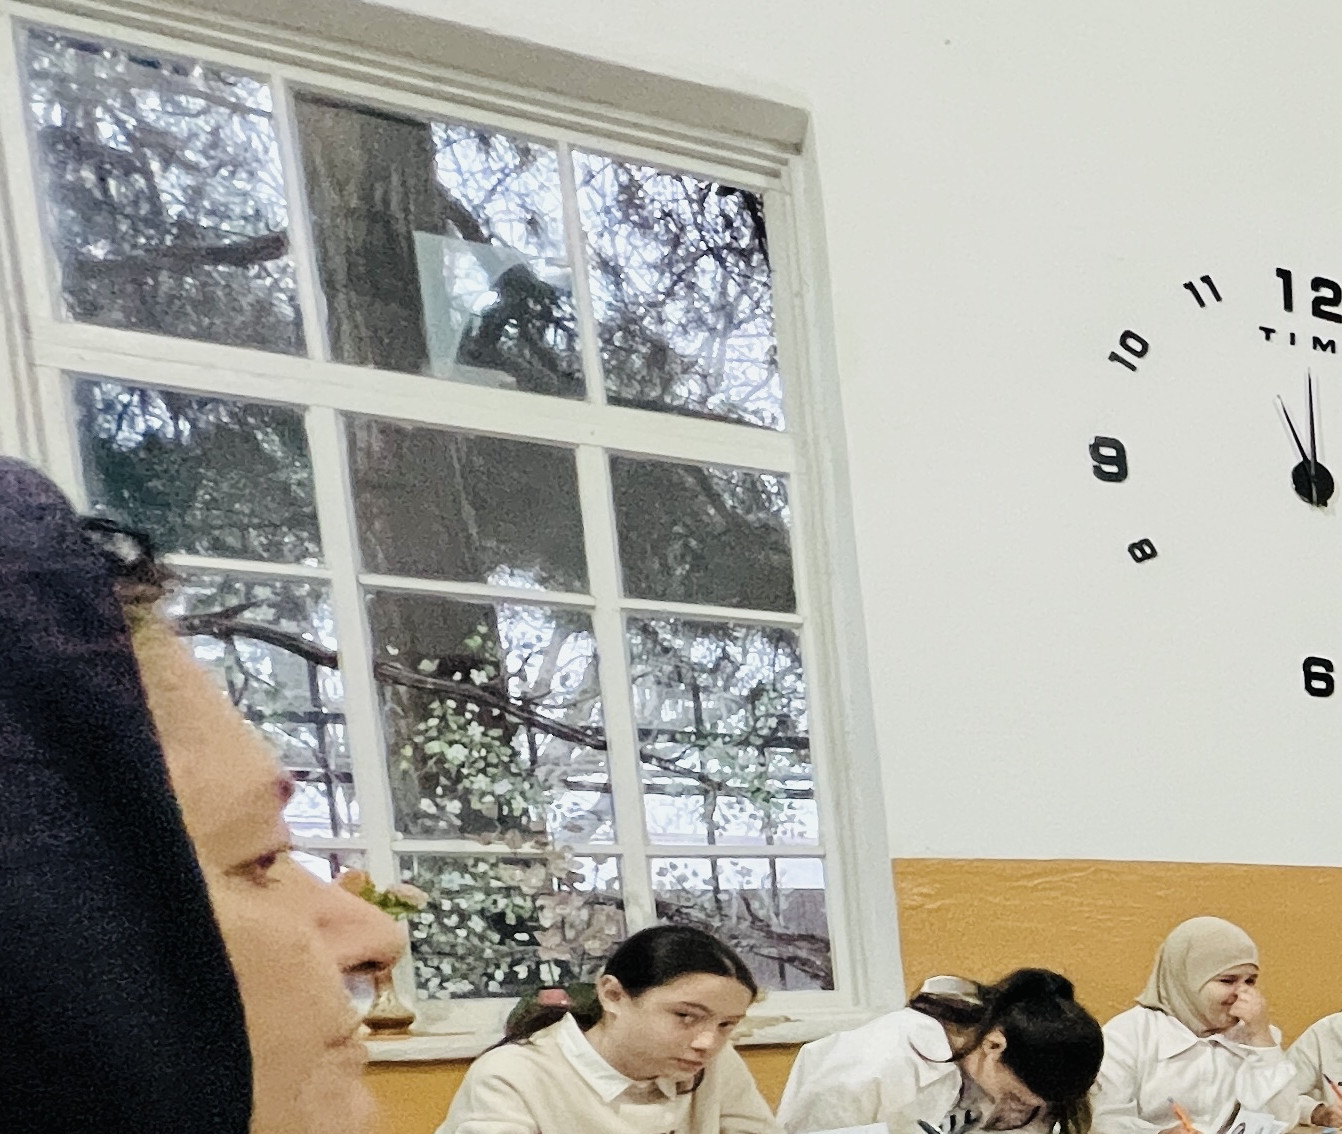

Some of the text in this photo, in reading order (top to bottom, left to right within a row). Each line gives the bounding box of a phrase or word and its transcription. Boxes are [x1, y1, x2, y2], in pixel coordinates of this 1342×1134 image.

[1182, 274, 1223, 308] 11
[1275, 267, 1342, 324] 12
[1107, 329, 1150, 372] 10
[1089, 435, 1129, 483] 9
[1127, 538, 1158, 564] 8
[1302, 656, 1335, 698] 6
